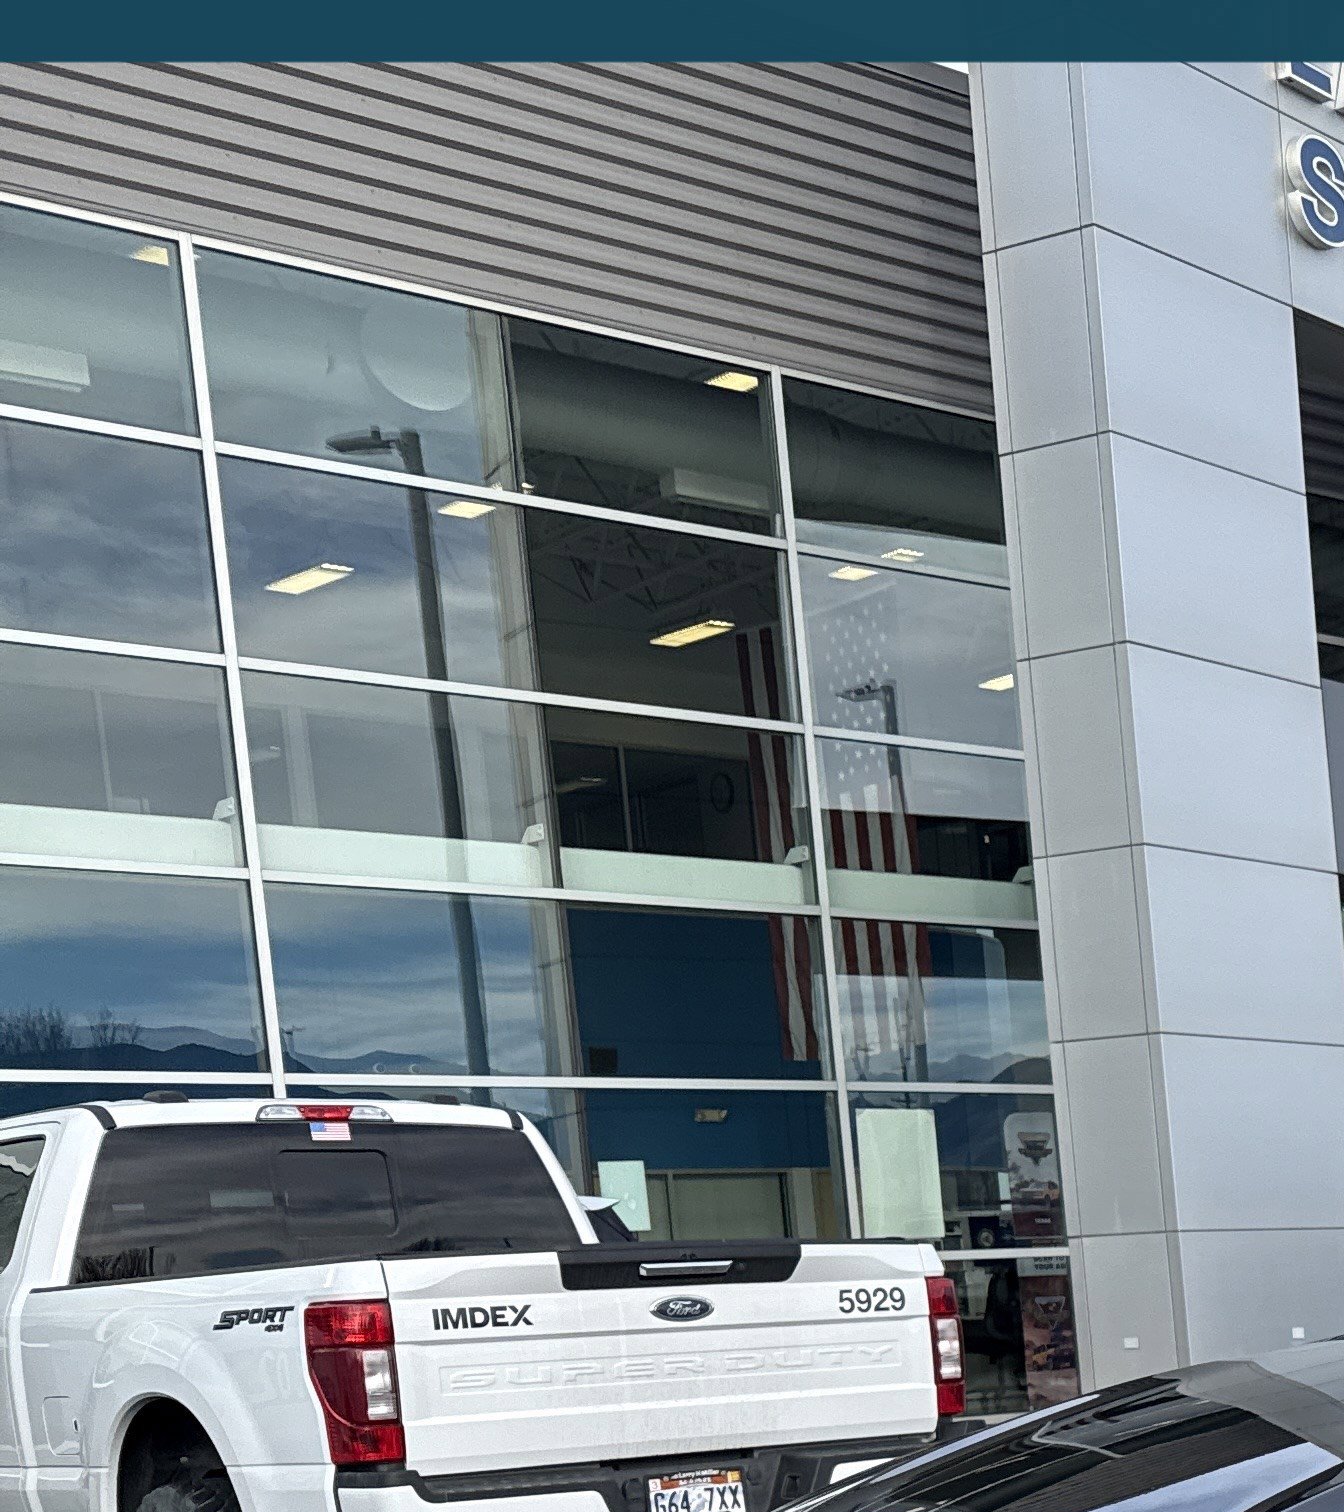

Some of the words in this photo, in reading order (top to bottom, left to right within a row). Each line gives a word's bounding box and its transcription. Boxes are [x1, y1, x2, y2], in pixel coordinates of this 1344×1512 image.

[667, 1300, 702, 1317] Ford
[838, 1287, 906, 1313] 5929
[213, 1306, 294, 1331] SPORT
[432, 1305, 534, 1331] IMDEX
[449, 1355, 706, 1391] SUPER
[722, 1345, 894, 1373] DUTY
[704, 1484, 741, 1512] 7XX
